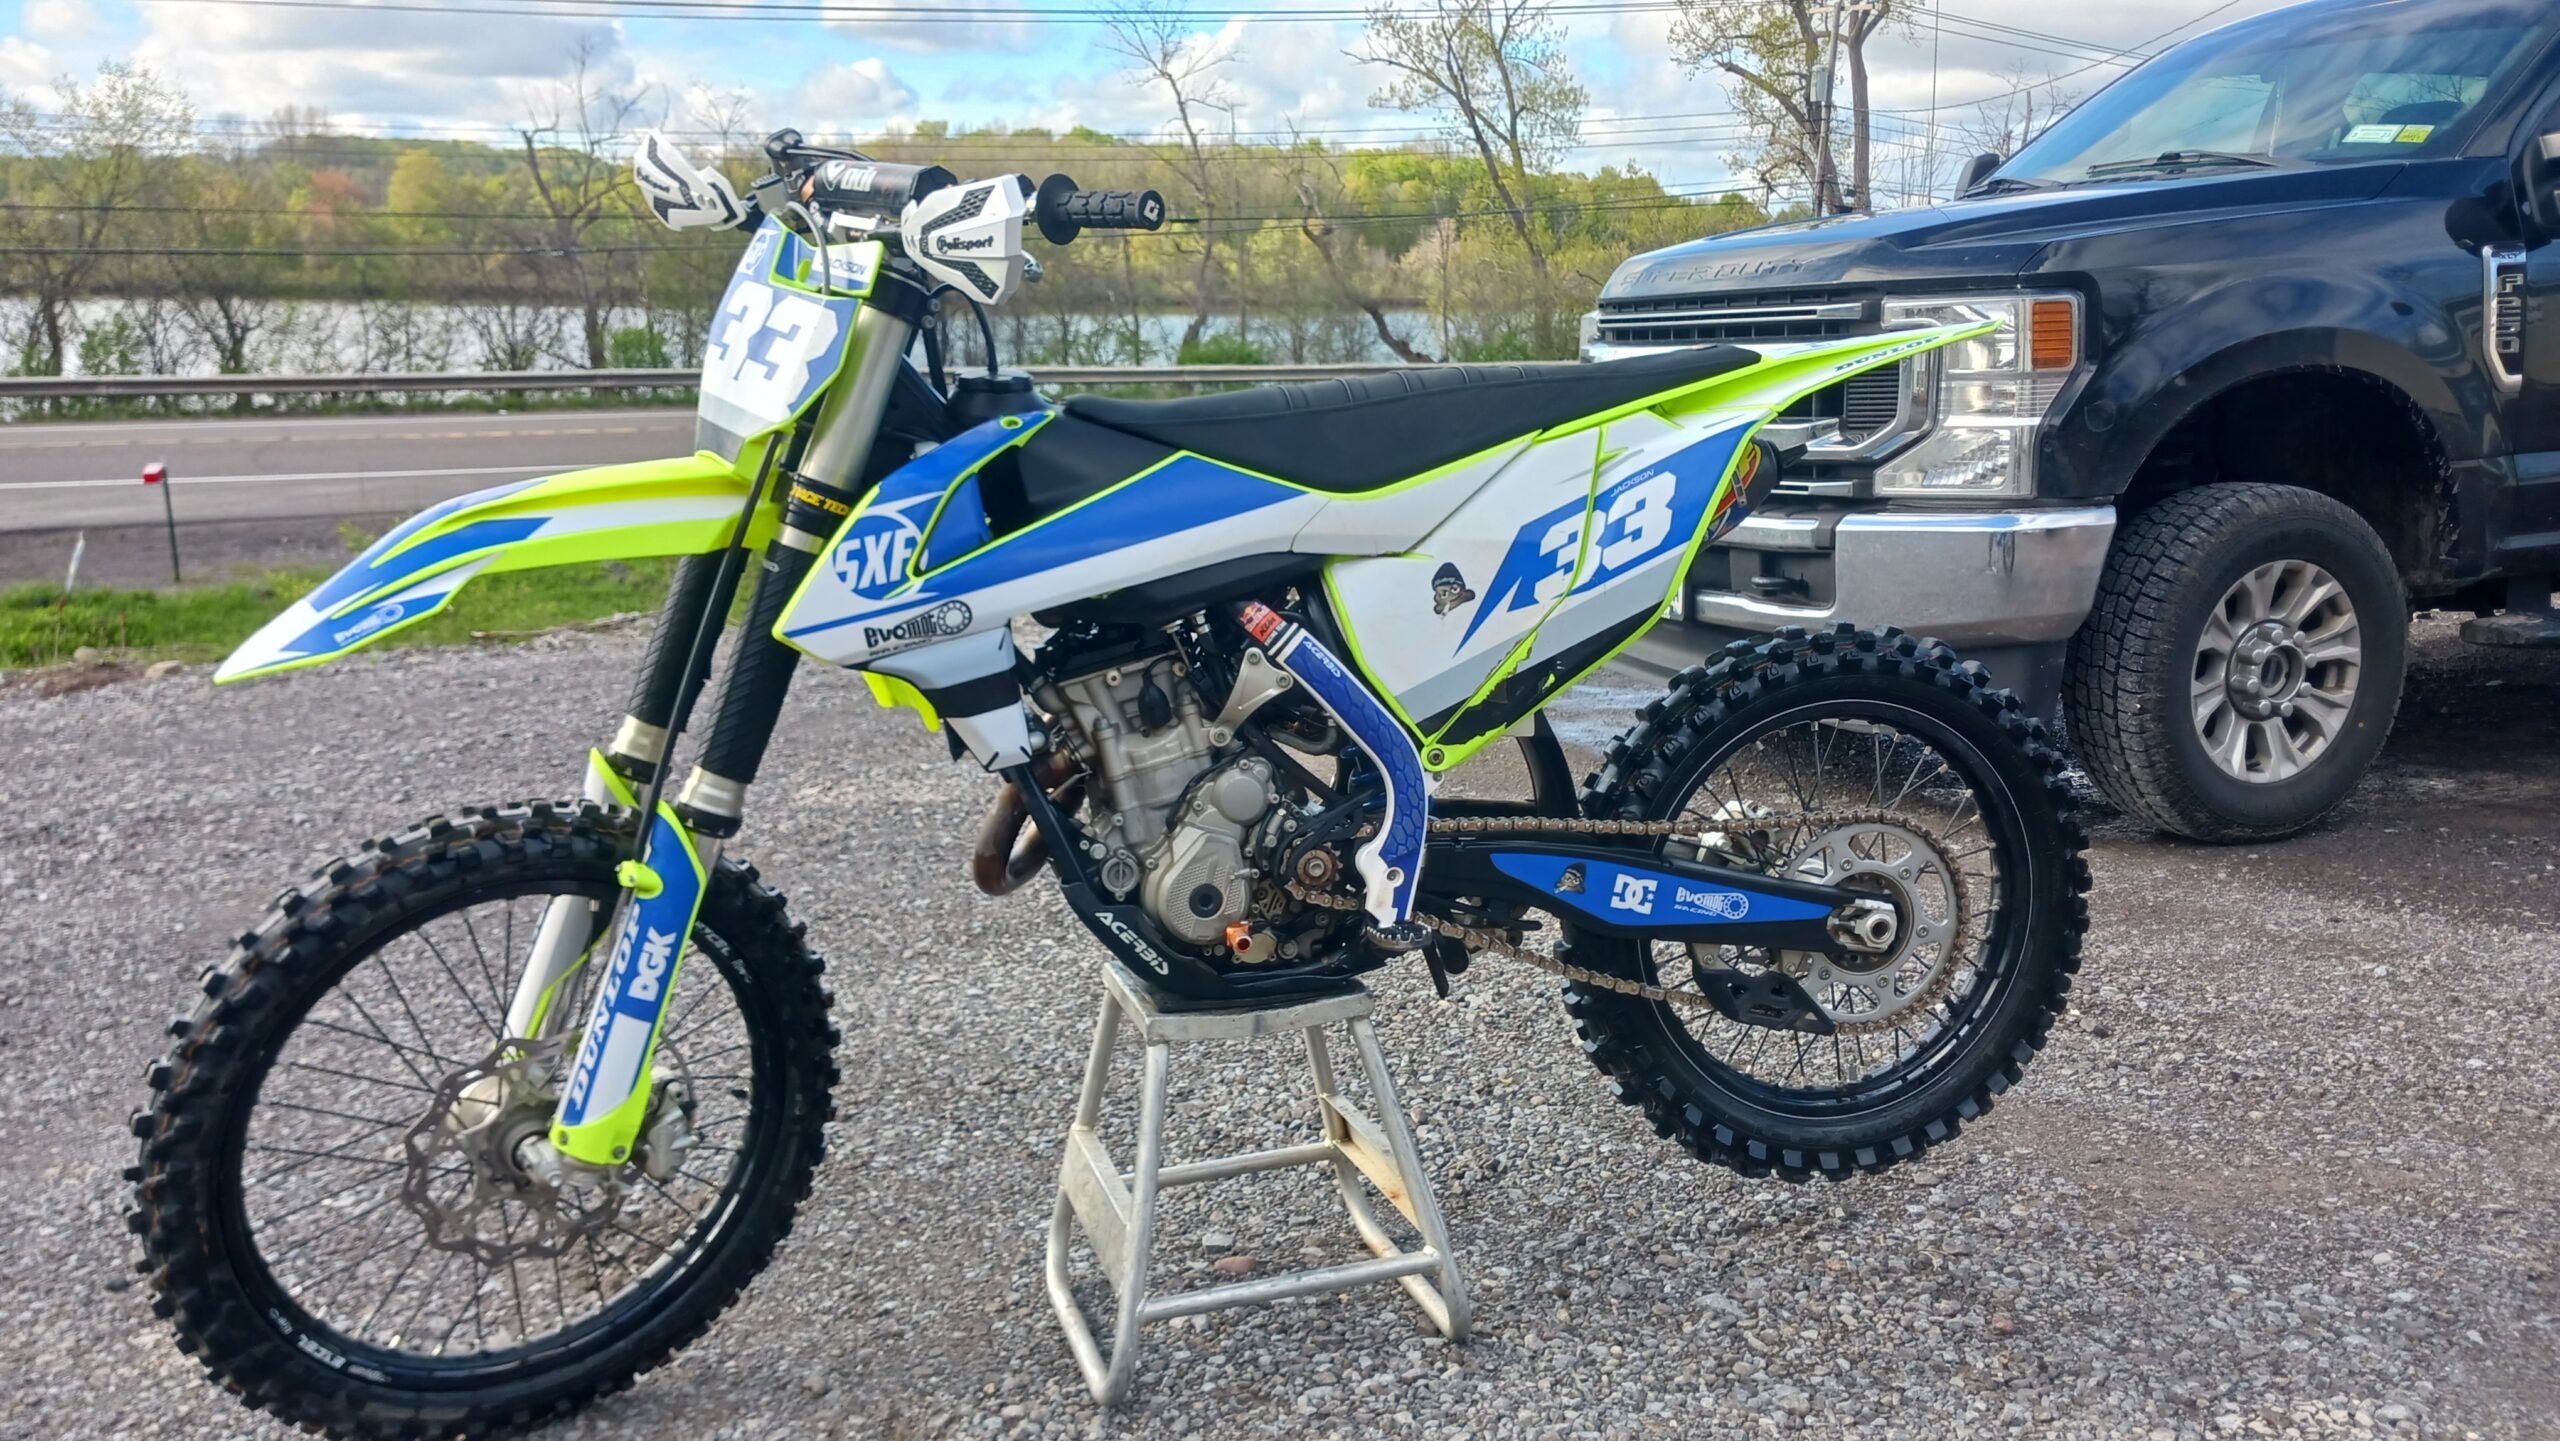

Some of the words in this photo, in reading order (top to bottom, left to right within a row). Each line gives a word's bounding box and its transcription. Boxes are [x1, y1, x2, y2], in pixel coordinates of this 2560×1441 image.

[820, 258, 868, 276] CKSON
[936, 235, 994, 254] Polisport
[1619, 265, 1714, 287] SUPER
[1713, 259, 1805, 279] DUTY
[2496, 273, 2524, 354] F250
[702, 280, 839, 416] 33
[1834, 336, 1940, 372] DUNLOP
[1610, 469, 1655, 498] JACKSON
[834, 527, 921, 592] SXF
[1533, 470, 1678, 600] 33
[1610, 873, 1659, 915] DC
[627, 926, 678, 1002] DGK
[1094, 912, 1169, 975] ACERBIS
[571, 902, 641, 1111] DUNLOP
